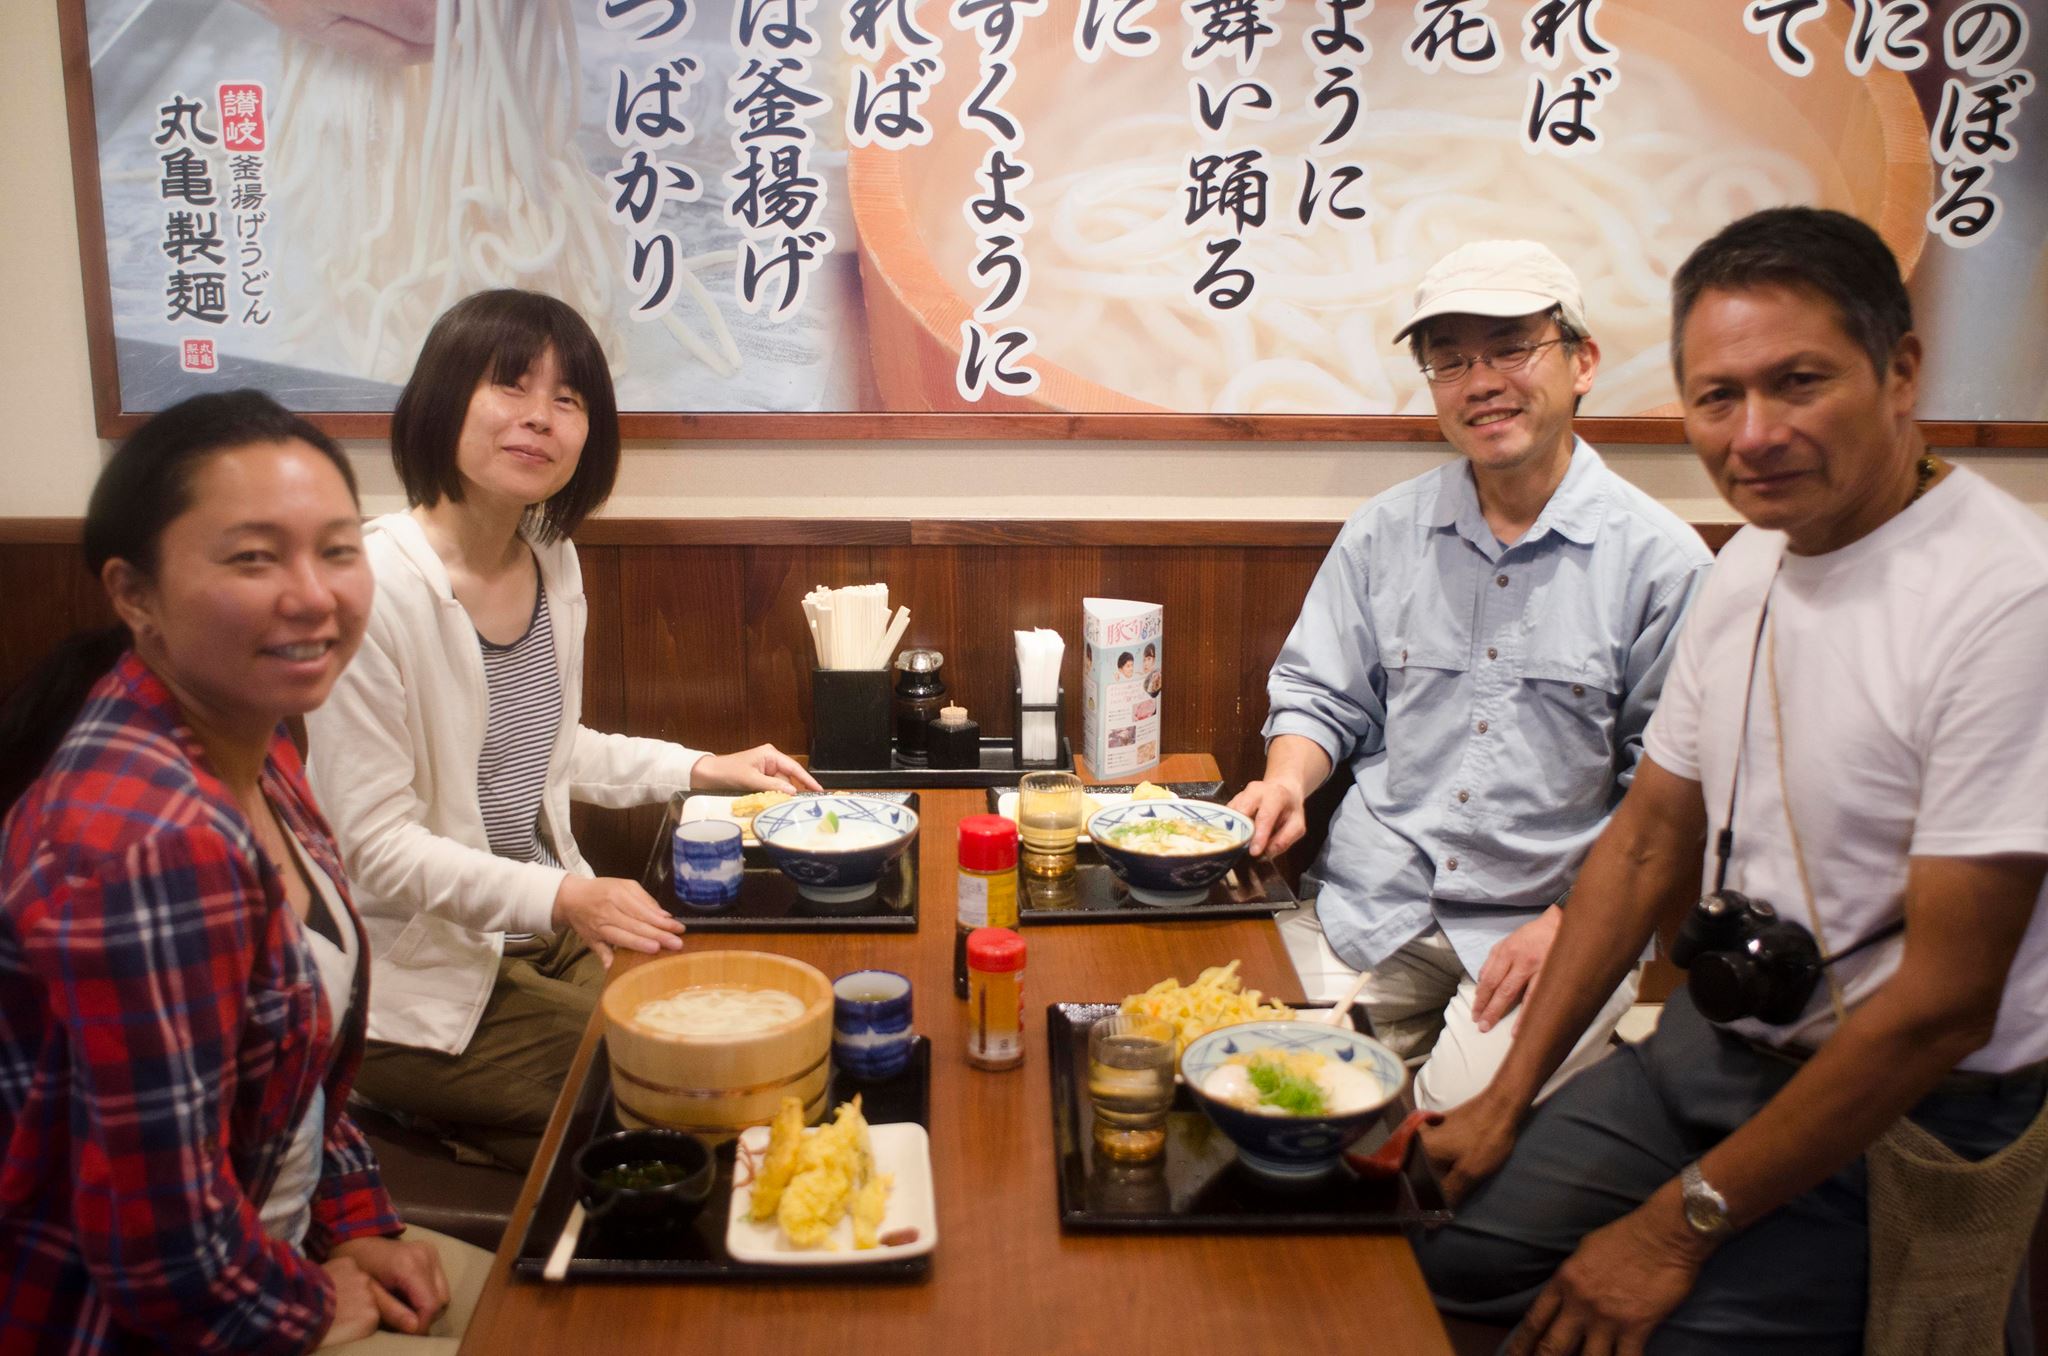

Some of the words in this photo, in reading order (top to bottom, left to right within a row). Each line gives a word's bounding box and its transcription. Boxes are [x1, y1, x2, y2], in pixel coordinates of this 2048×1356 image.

[1410, 0, 1496, 61] 花
[1529, 0, 1612, 145] れば
[1752, 0, 1818, 64] て
[1854, 0, 1920, 64] に
[222, 90, 263, 146] 讃岐
[1185, 0, 1273, 310] 舞い踊る
[1299, 0, 1366, 225] ように
[1935, 3, 2027, 237] のぼる
[155, 95, 229, 324] 丸亀製麺
[229, 154, 271, 325] 釜揚げうどん
